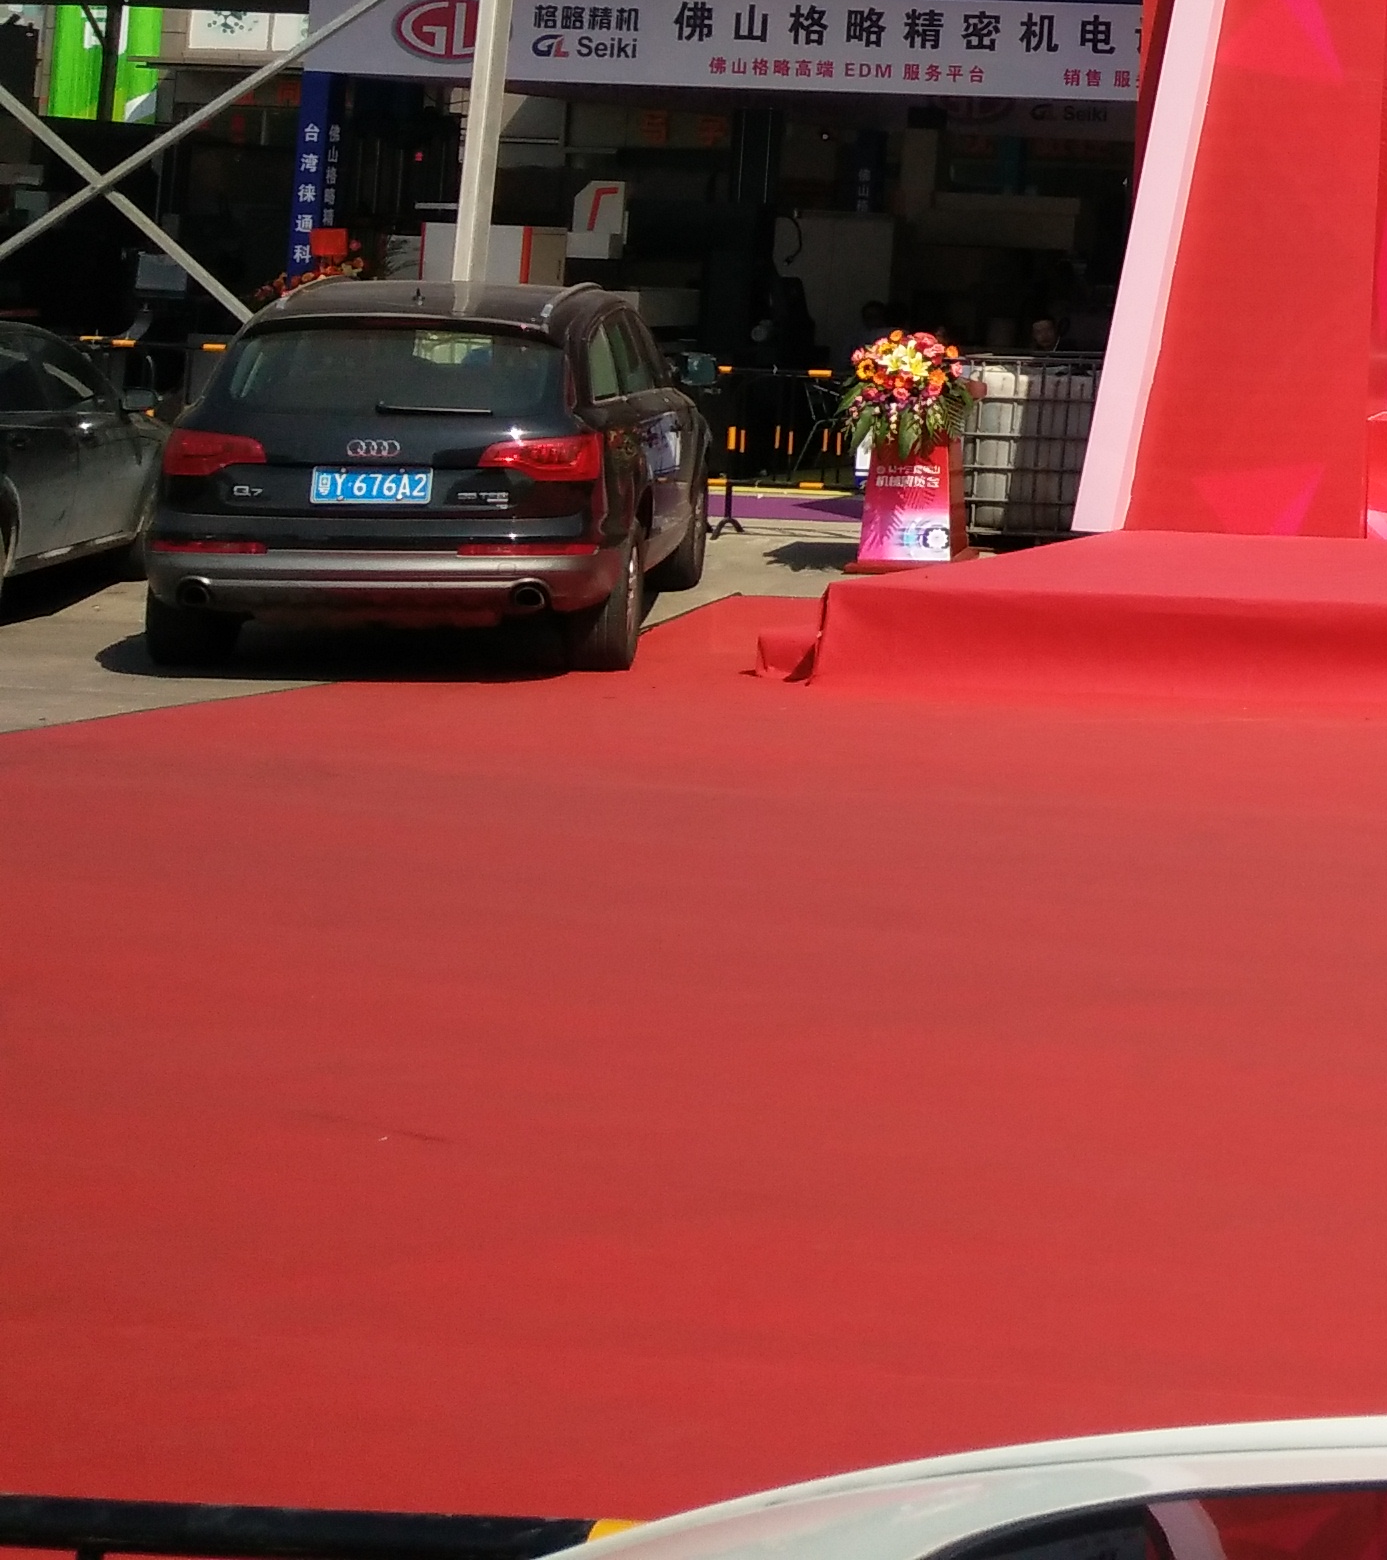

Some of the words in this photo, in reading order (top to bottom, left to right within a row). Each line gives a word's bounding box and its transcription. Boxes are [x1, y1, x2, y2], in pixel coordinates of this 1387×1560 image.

[533, 4, 639, 33] 格略精机
[673, 0, 1142, 56] 佛山格略精密机电
[577, 35, 637, 59] Seiki
[708, 56, 834, 79] 佛山格略高端
[844, 62, 893, 80] EDM
[902, 64, 986, 84] 服务平台
